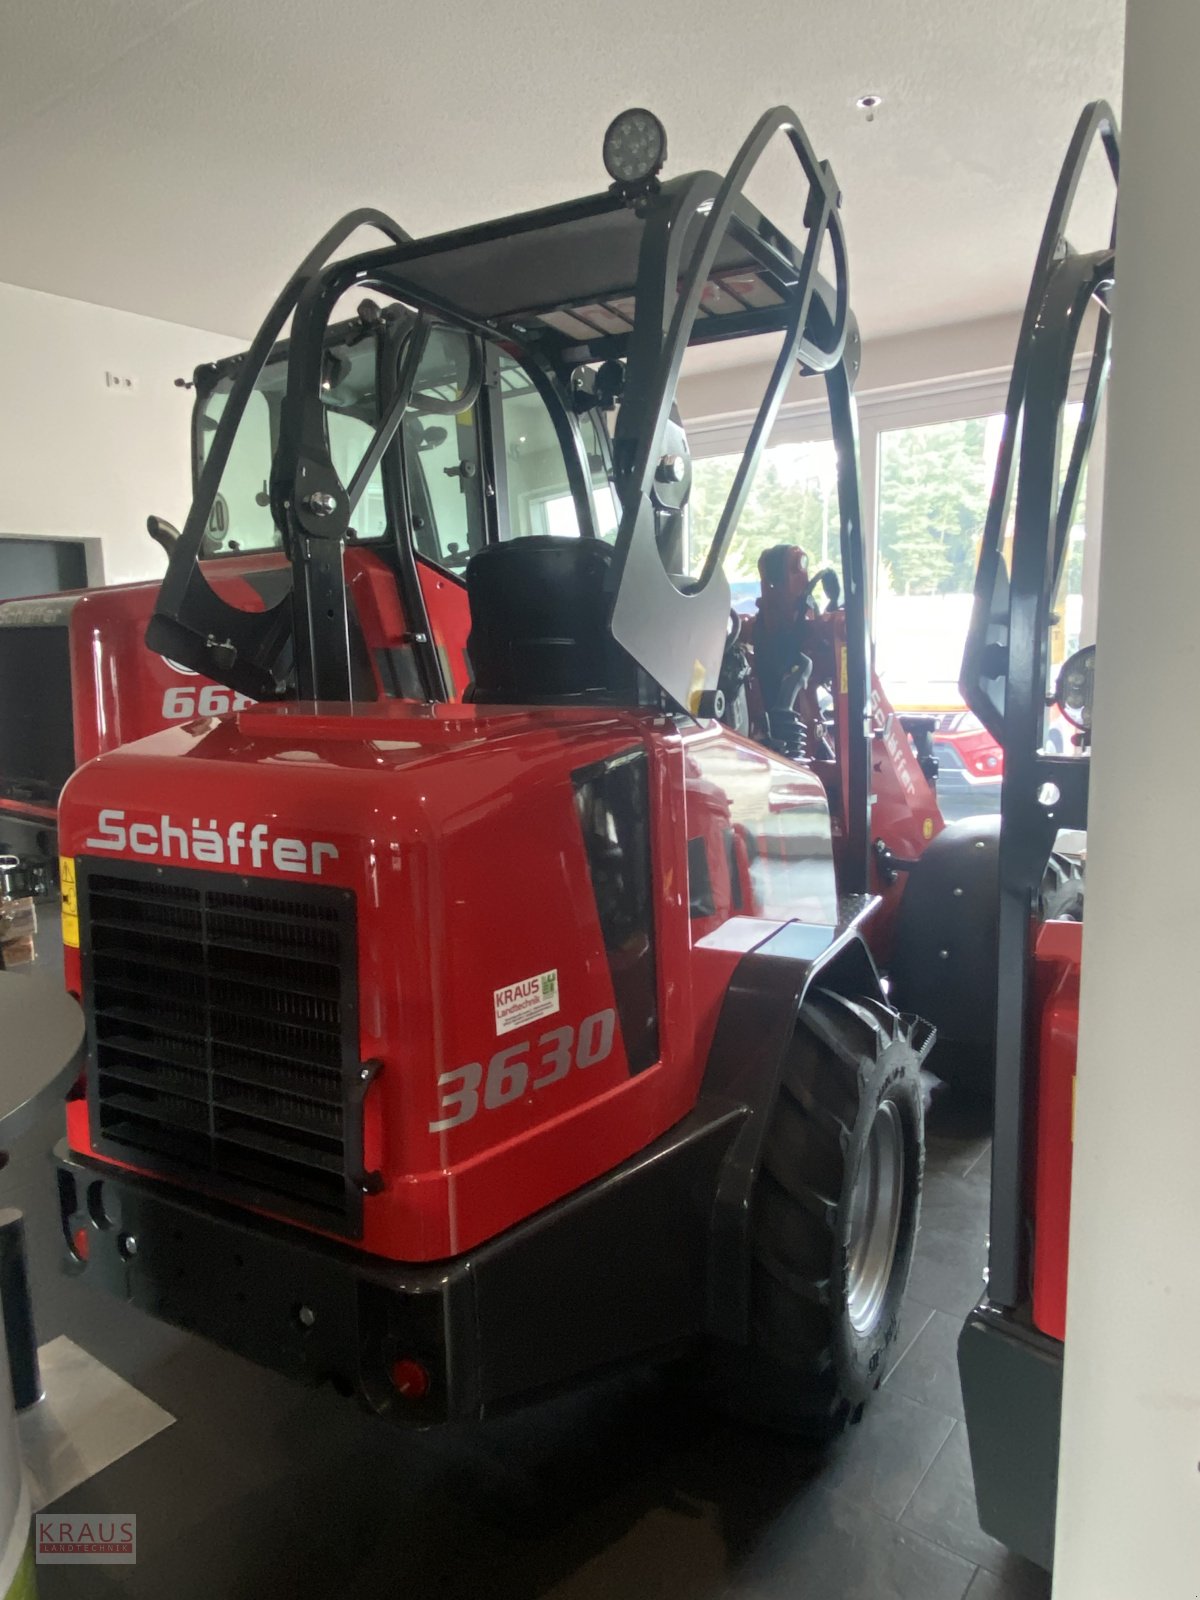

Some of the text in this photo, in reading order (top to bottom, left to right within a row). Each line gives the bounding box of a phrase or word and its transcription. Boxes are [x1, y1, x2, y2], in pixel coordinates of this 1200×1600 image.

[86, 809, 339, 875] Schäffer
[496, 978, 540, 1008] KRAUS
[497, 996, 541, 1019] Landtechnik
[428, 1008, 616, 1134] 3630
